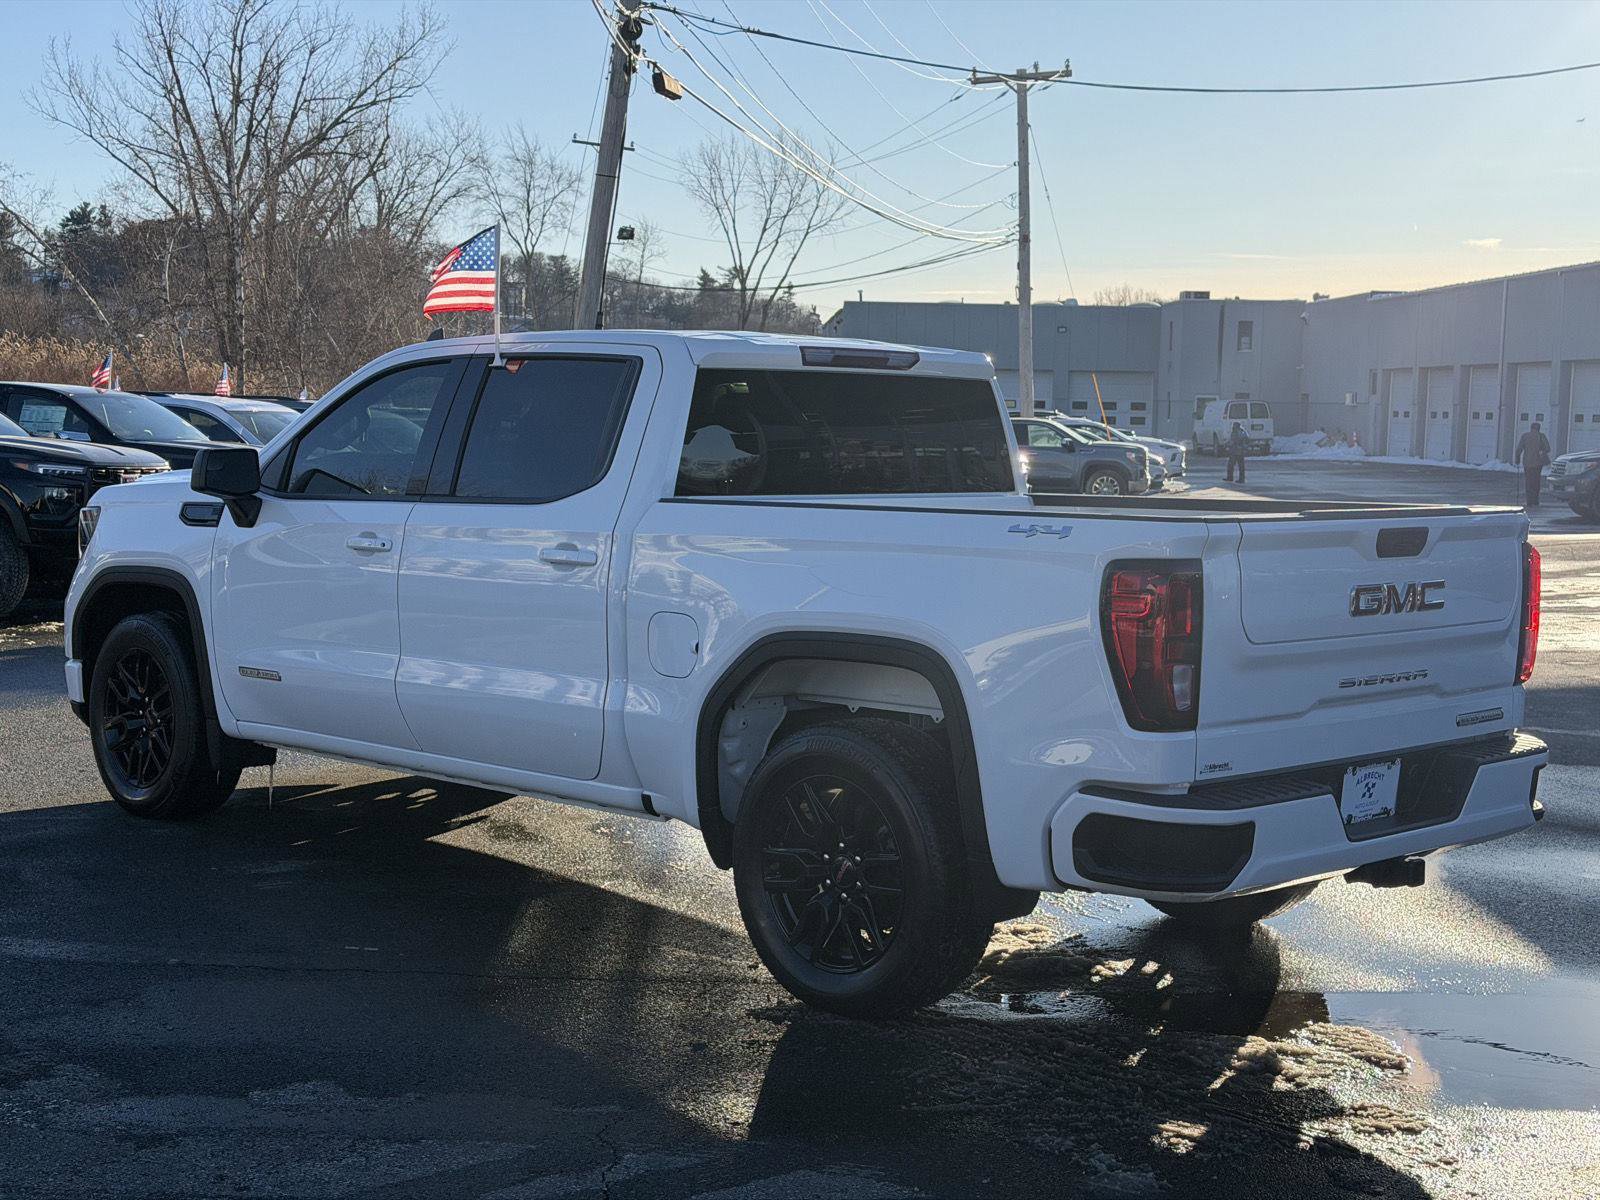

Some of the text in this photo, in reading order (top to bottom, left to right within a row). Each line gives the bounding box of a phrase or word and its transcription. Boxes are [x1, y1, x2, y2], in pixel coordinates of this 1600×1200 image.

[1349, 579, 1446, 616] GMC
[1339, 669, 1428, 688] SIERRA
[1356, 770, 1385, 786] ALBRECHT
